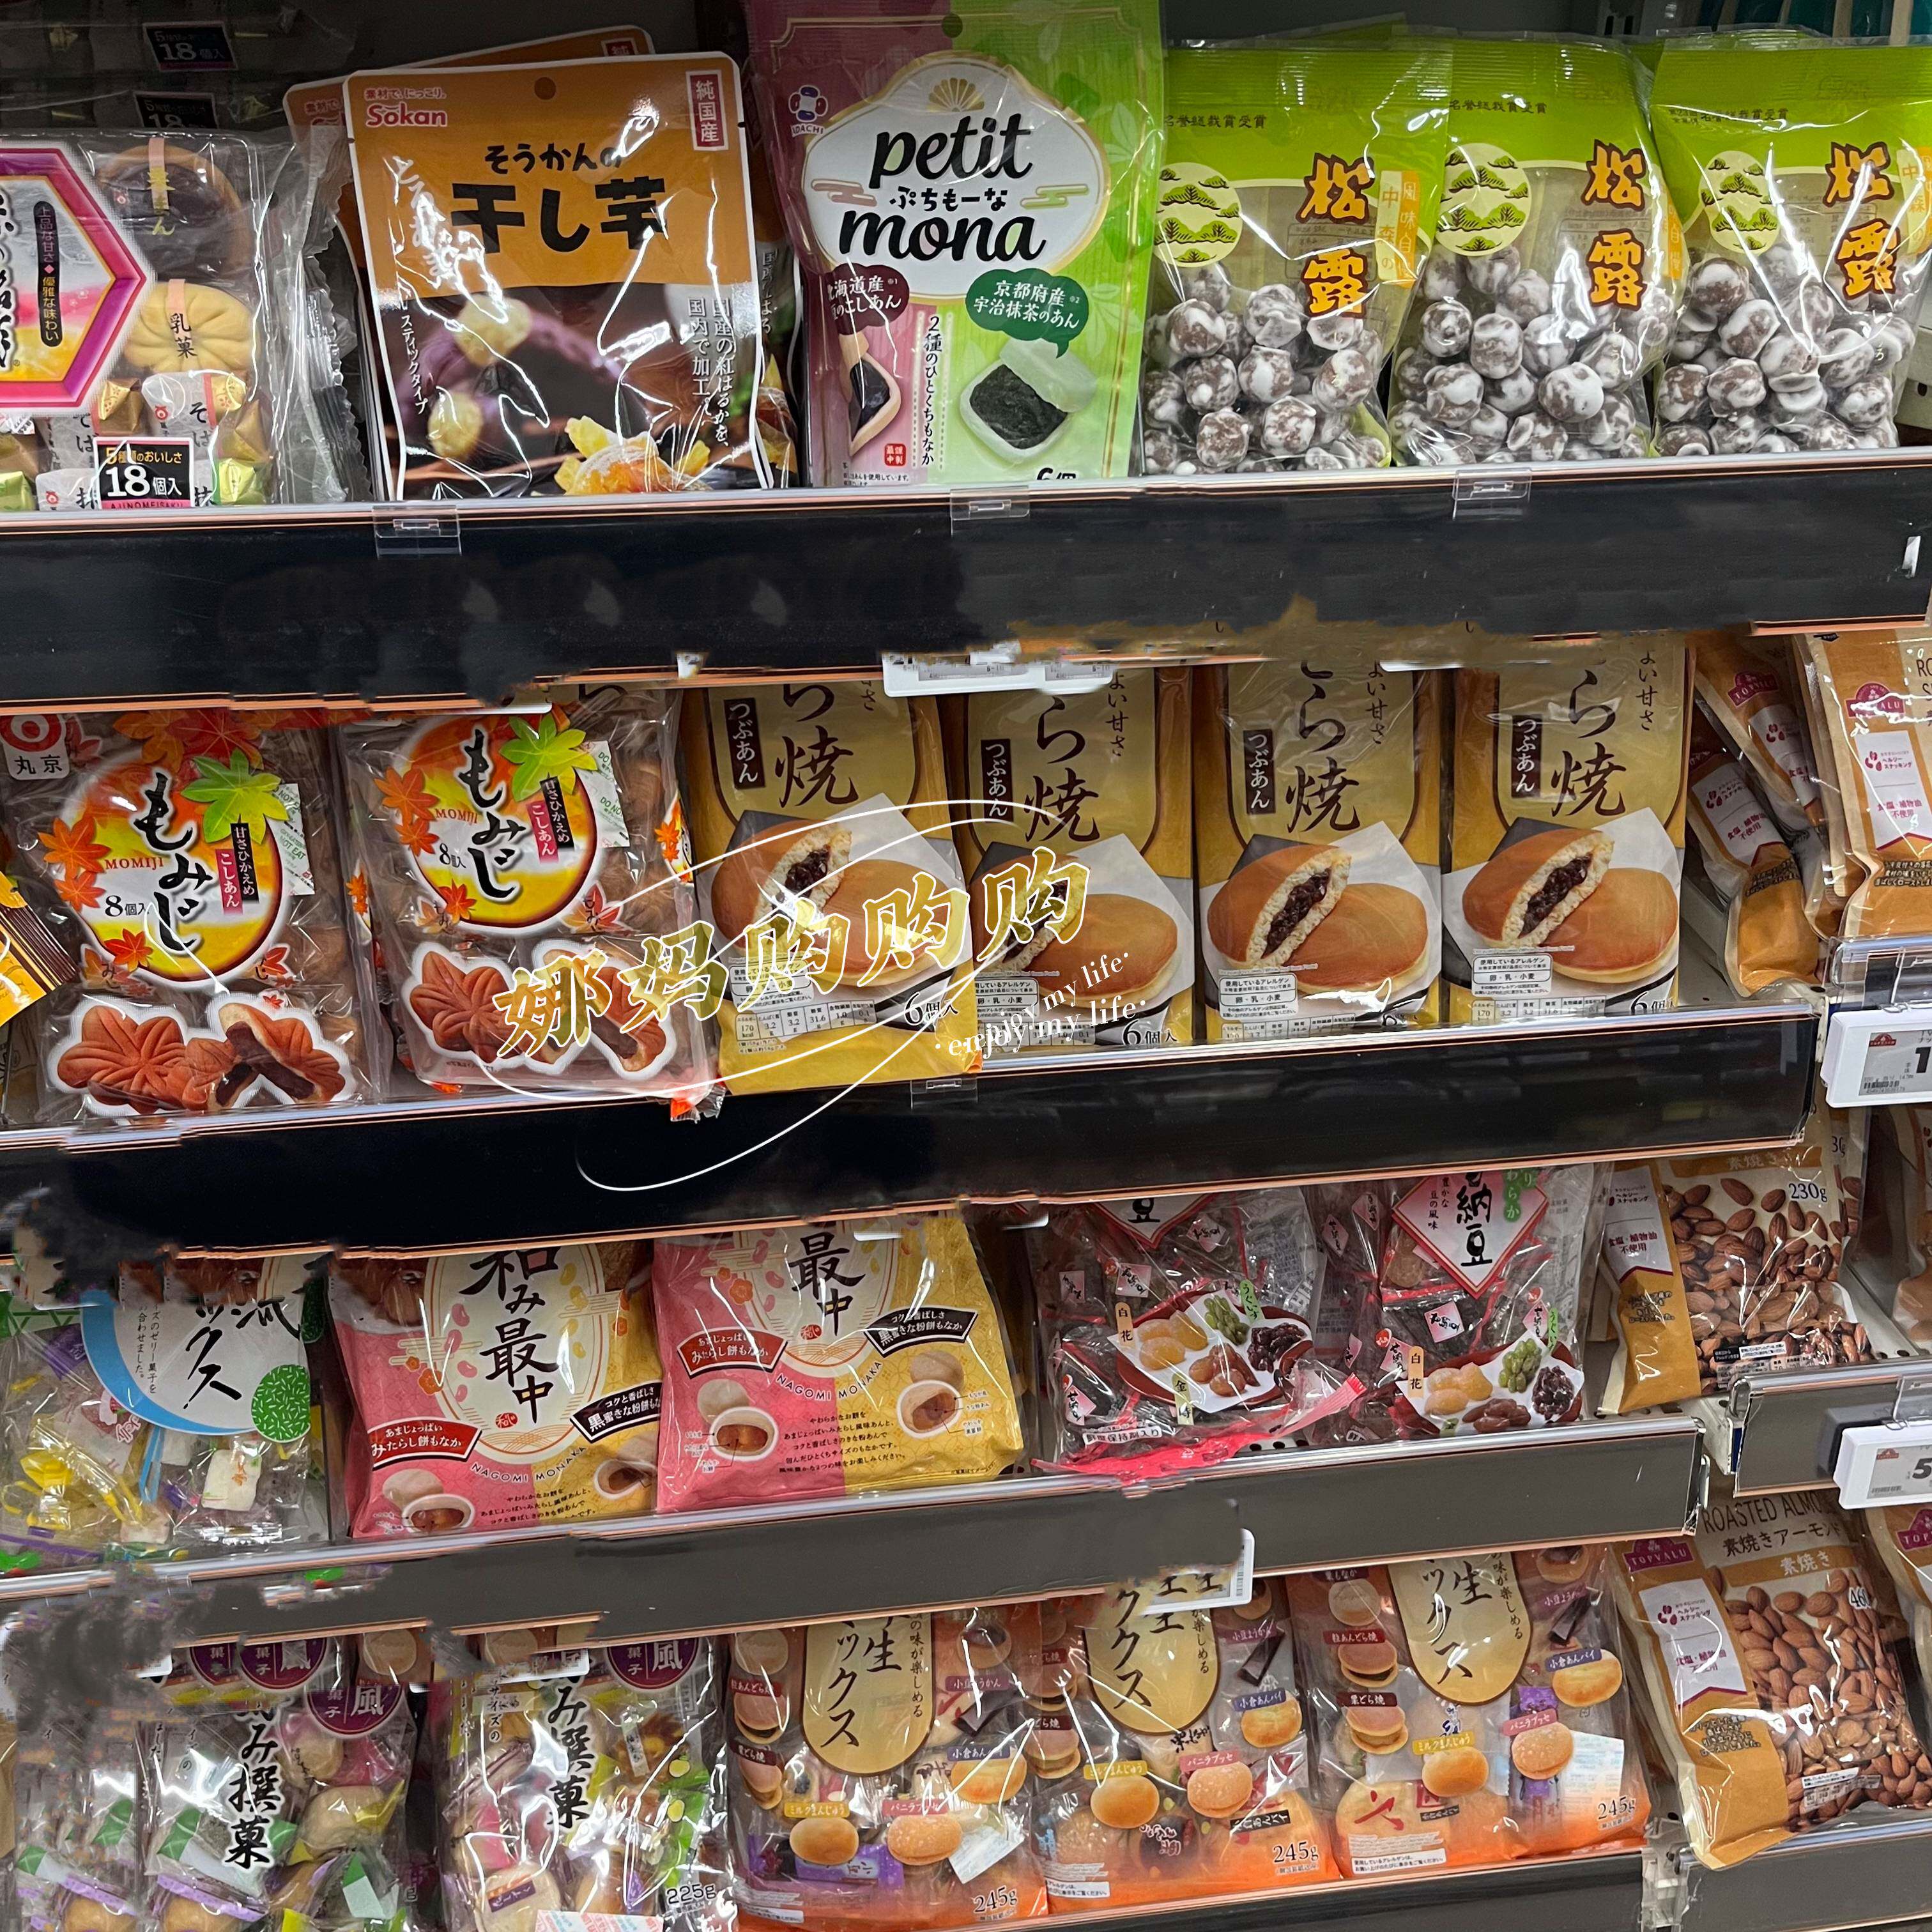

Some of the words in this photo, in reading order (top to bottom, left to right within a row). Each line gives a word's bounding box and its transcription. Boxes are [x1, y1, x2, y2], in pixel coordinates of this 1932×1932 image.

[695, 80, 719, 142] 純国産
[485, 142, 622, 174] そうかんの
[868, 113, 1033, 189] petit
[452, 176, 668, 254] 干し芋
[889, 186, 1008, 211] ぷちもーな
[39, 206, 55, 263] 上品な甘さ
[838, 210, 1047, 261] mona
[42, 276, 59, 341] 優雅な味わい
[974, 296, 1080, 330] 宇治抹茶のあん
[993, 280, 1066, 307] 京都府産
[170, 313, 197, 358] 乳菓
[686, 297, 710, 397] 国内で加工
[400, 314, 429, 415] スティックタイプ
[921, 316, 942, 466] 2種のひとくちもなか
[105, 465, 182, 497] 18個入
[1636, 650, 1658, 731] よい甘さ
[14, 755, 63, 774] 丸京
[730, 703, 759, 784] つぶあん
[1515, 718, 1535, 793] つぶあん
[985, 743, 1008, 817] つぶあん
[1248, 733, 1270, 809] つぶあん
[436, 808, 478, 824] MOMIJI
[458, 728, 527, 899] もみじ
[531, 803, 555, 856] こしあん
[544, 781, 570, 843] 甘さひかえめ
[105, 857, 164, 871] MOMIJI
[134, 772, 215, 951] もみじ
[219, 852, 241, 908] こしあん
[233, 827, 256, 897] 甘さひかえめ
[105, 895, 151, 917] 8個入
[1788, 1183, 1828, 1202] 230g
[789, 1231, 866, 1337] 最中
[459, 1246, 559, 1423] 和み最中
[776, 1374, 832, 1400] NAGOMI
[838, 1361, 882, 1399] MONAKA
[1409, 1353, 1423, 1390] 白花
[371, 1436, 462, 1458] みたらし餅もなか
[385, 1423, 442, 1438] あまじょっぱい
[471, 1462, 528, 1482] NAGOMI
[535, 1445, 587, 1480] MONAKA
[1701, 1496, 1778, 1535] ROASTED
[1630, 1549, 1687, 1565] TOPVALU
[1780, 1550, 1830, 1576] 素焼き
[1422, 1559, 1473, 1685] ックス
[820, 1620, 860, 1748] ックス
[224, 1702, 282, 1869] み撰菓
[1597, 1796, 1636, 1821] 245g
[1273, 1841, 1319, 1864] 245g
[666, 1883, 717, 1905] 225g
[973, 1887, 1018, 1914] 245g
